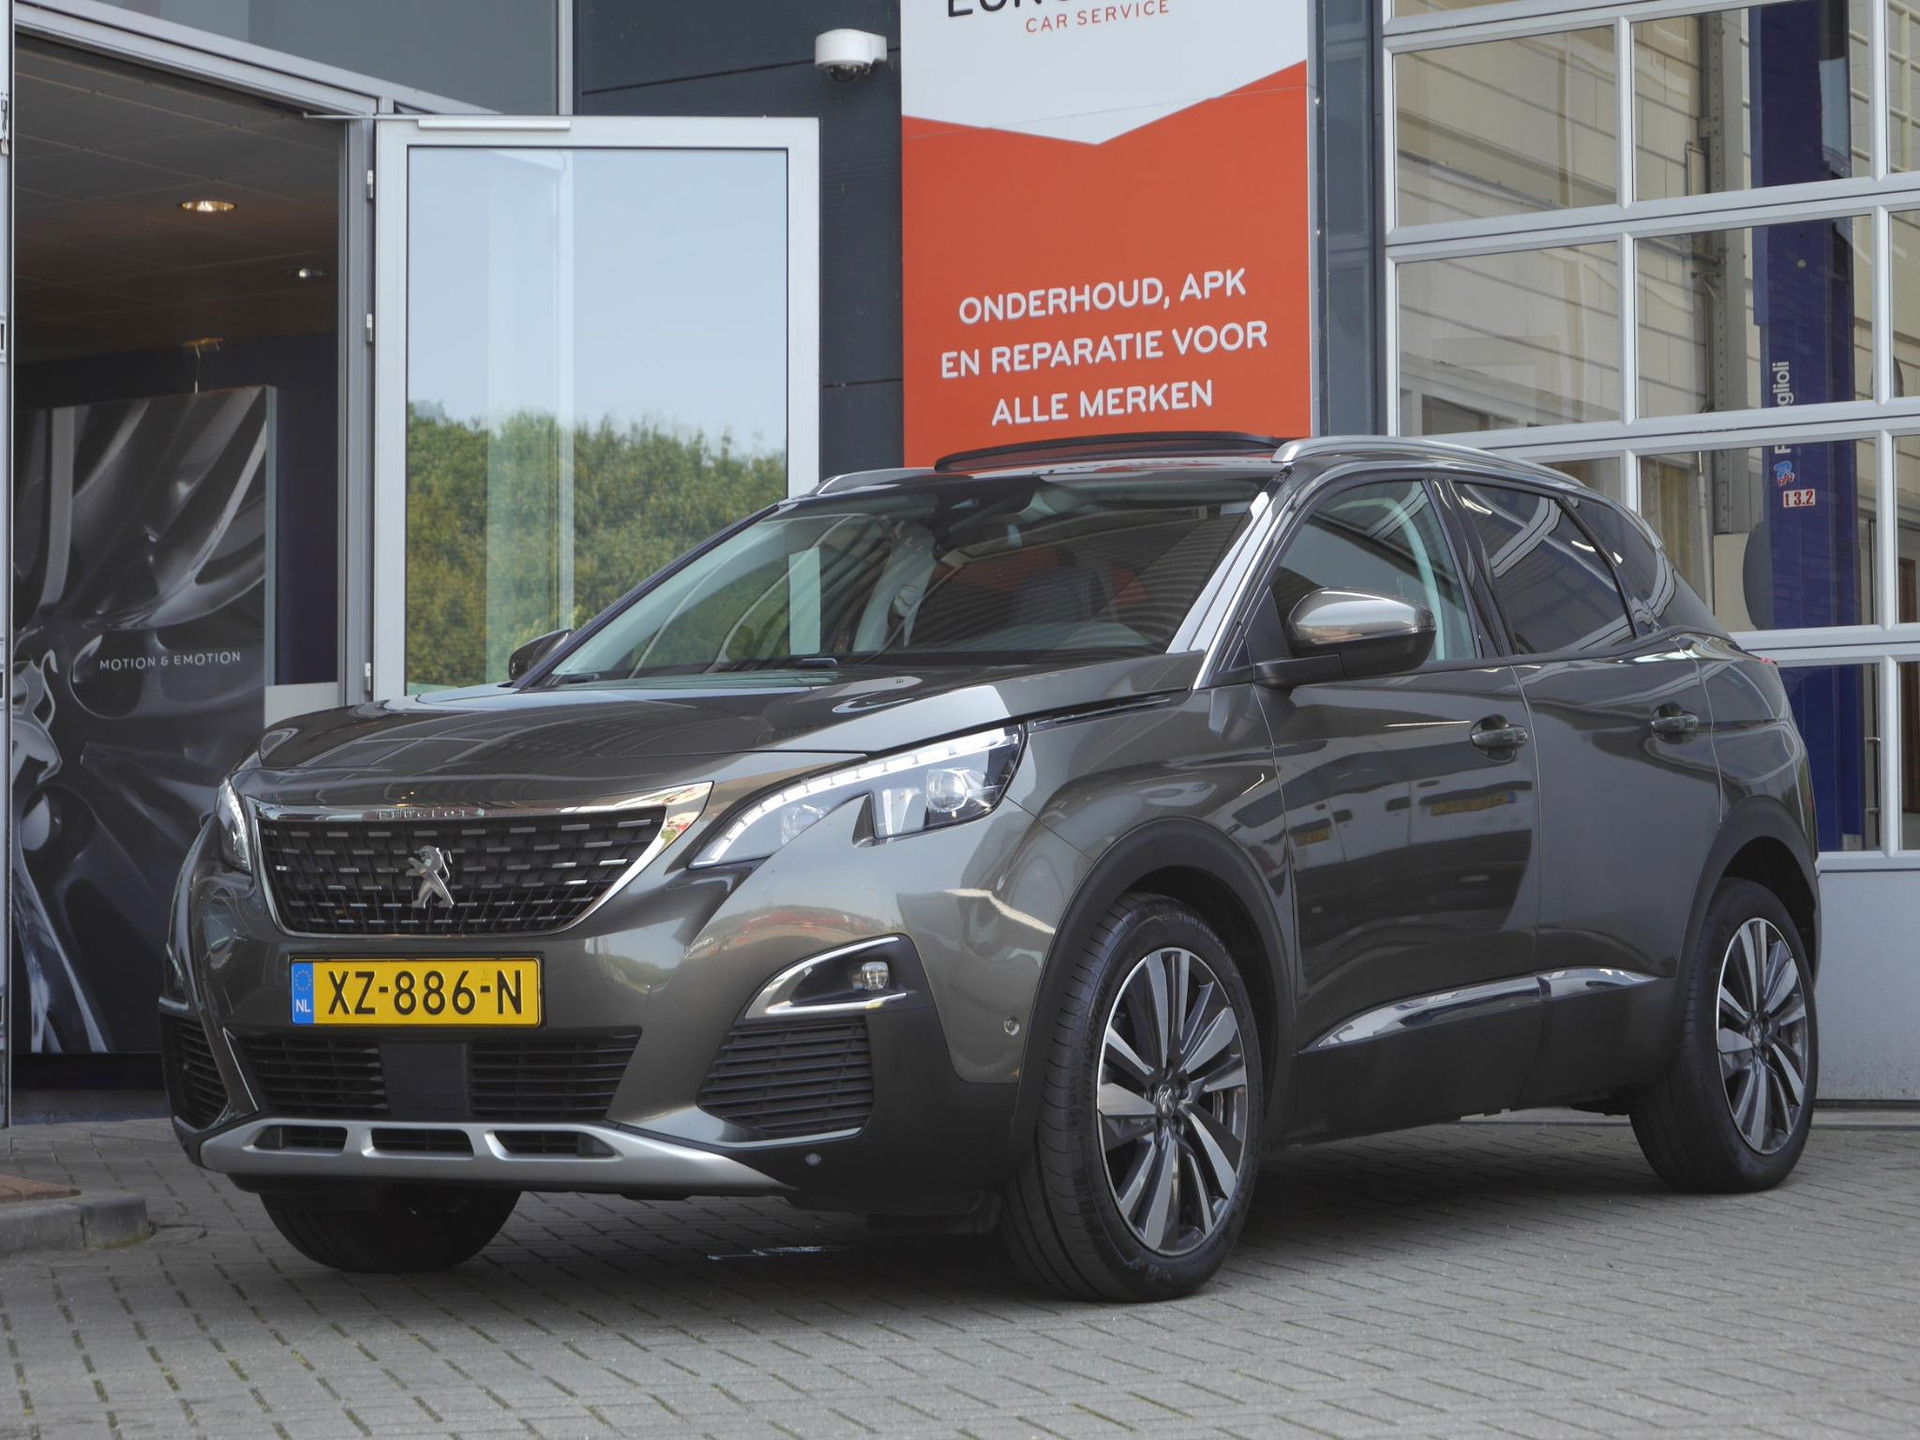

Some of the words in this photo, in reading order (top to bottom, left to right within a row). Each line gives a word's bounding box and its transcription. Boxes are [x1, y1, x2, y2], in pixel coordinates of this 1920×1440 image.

[1024, 14, 1069, 34] CAR
[1077, 0, 1170, 27] SERVICE
[958, 278, 1170, 325] ONDERHOUD,
[1179, 267, 1247, 302] APK
[941, 349, 980, 379] EN
[991, 331, 1164, 374] REPARATIE
[1171, 320, 1268, 356] VOOR
[991, 393, 1069, 427] ALLE
[1079, 378, 1214, 419] MERKEN
[100, 656, 156, 671] MOTION
[160, 655, 169, 667] &
[173, 651, 241, 667] EMOTION
[295, 999, 311, 1013] NL
[328, 970, 522, 1016] XZ-886-N
